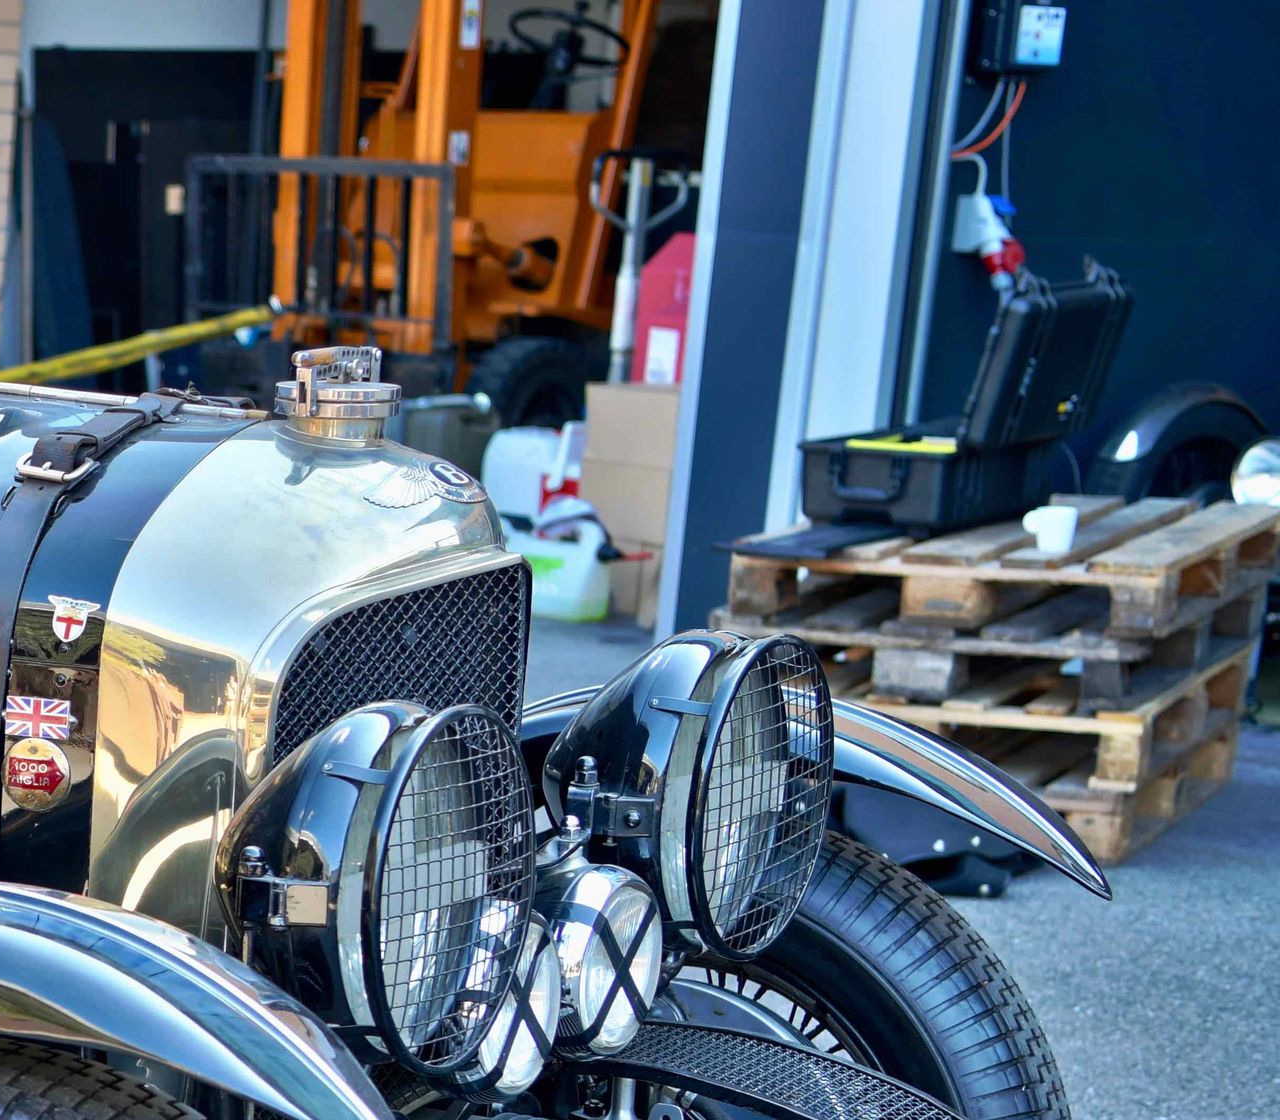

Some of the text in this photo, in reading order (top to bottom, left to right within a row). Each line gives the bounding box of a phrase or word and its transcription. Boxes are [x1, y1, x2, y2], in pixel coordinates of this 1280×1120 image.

[434, 463, 470, 484] B
[11, 761, 48, 774] 1000
[9, 774, 51, 787] MIGLIA
